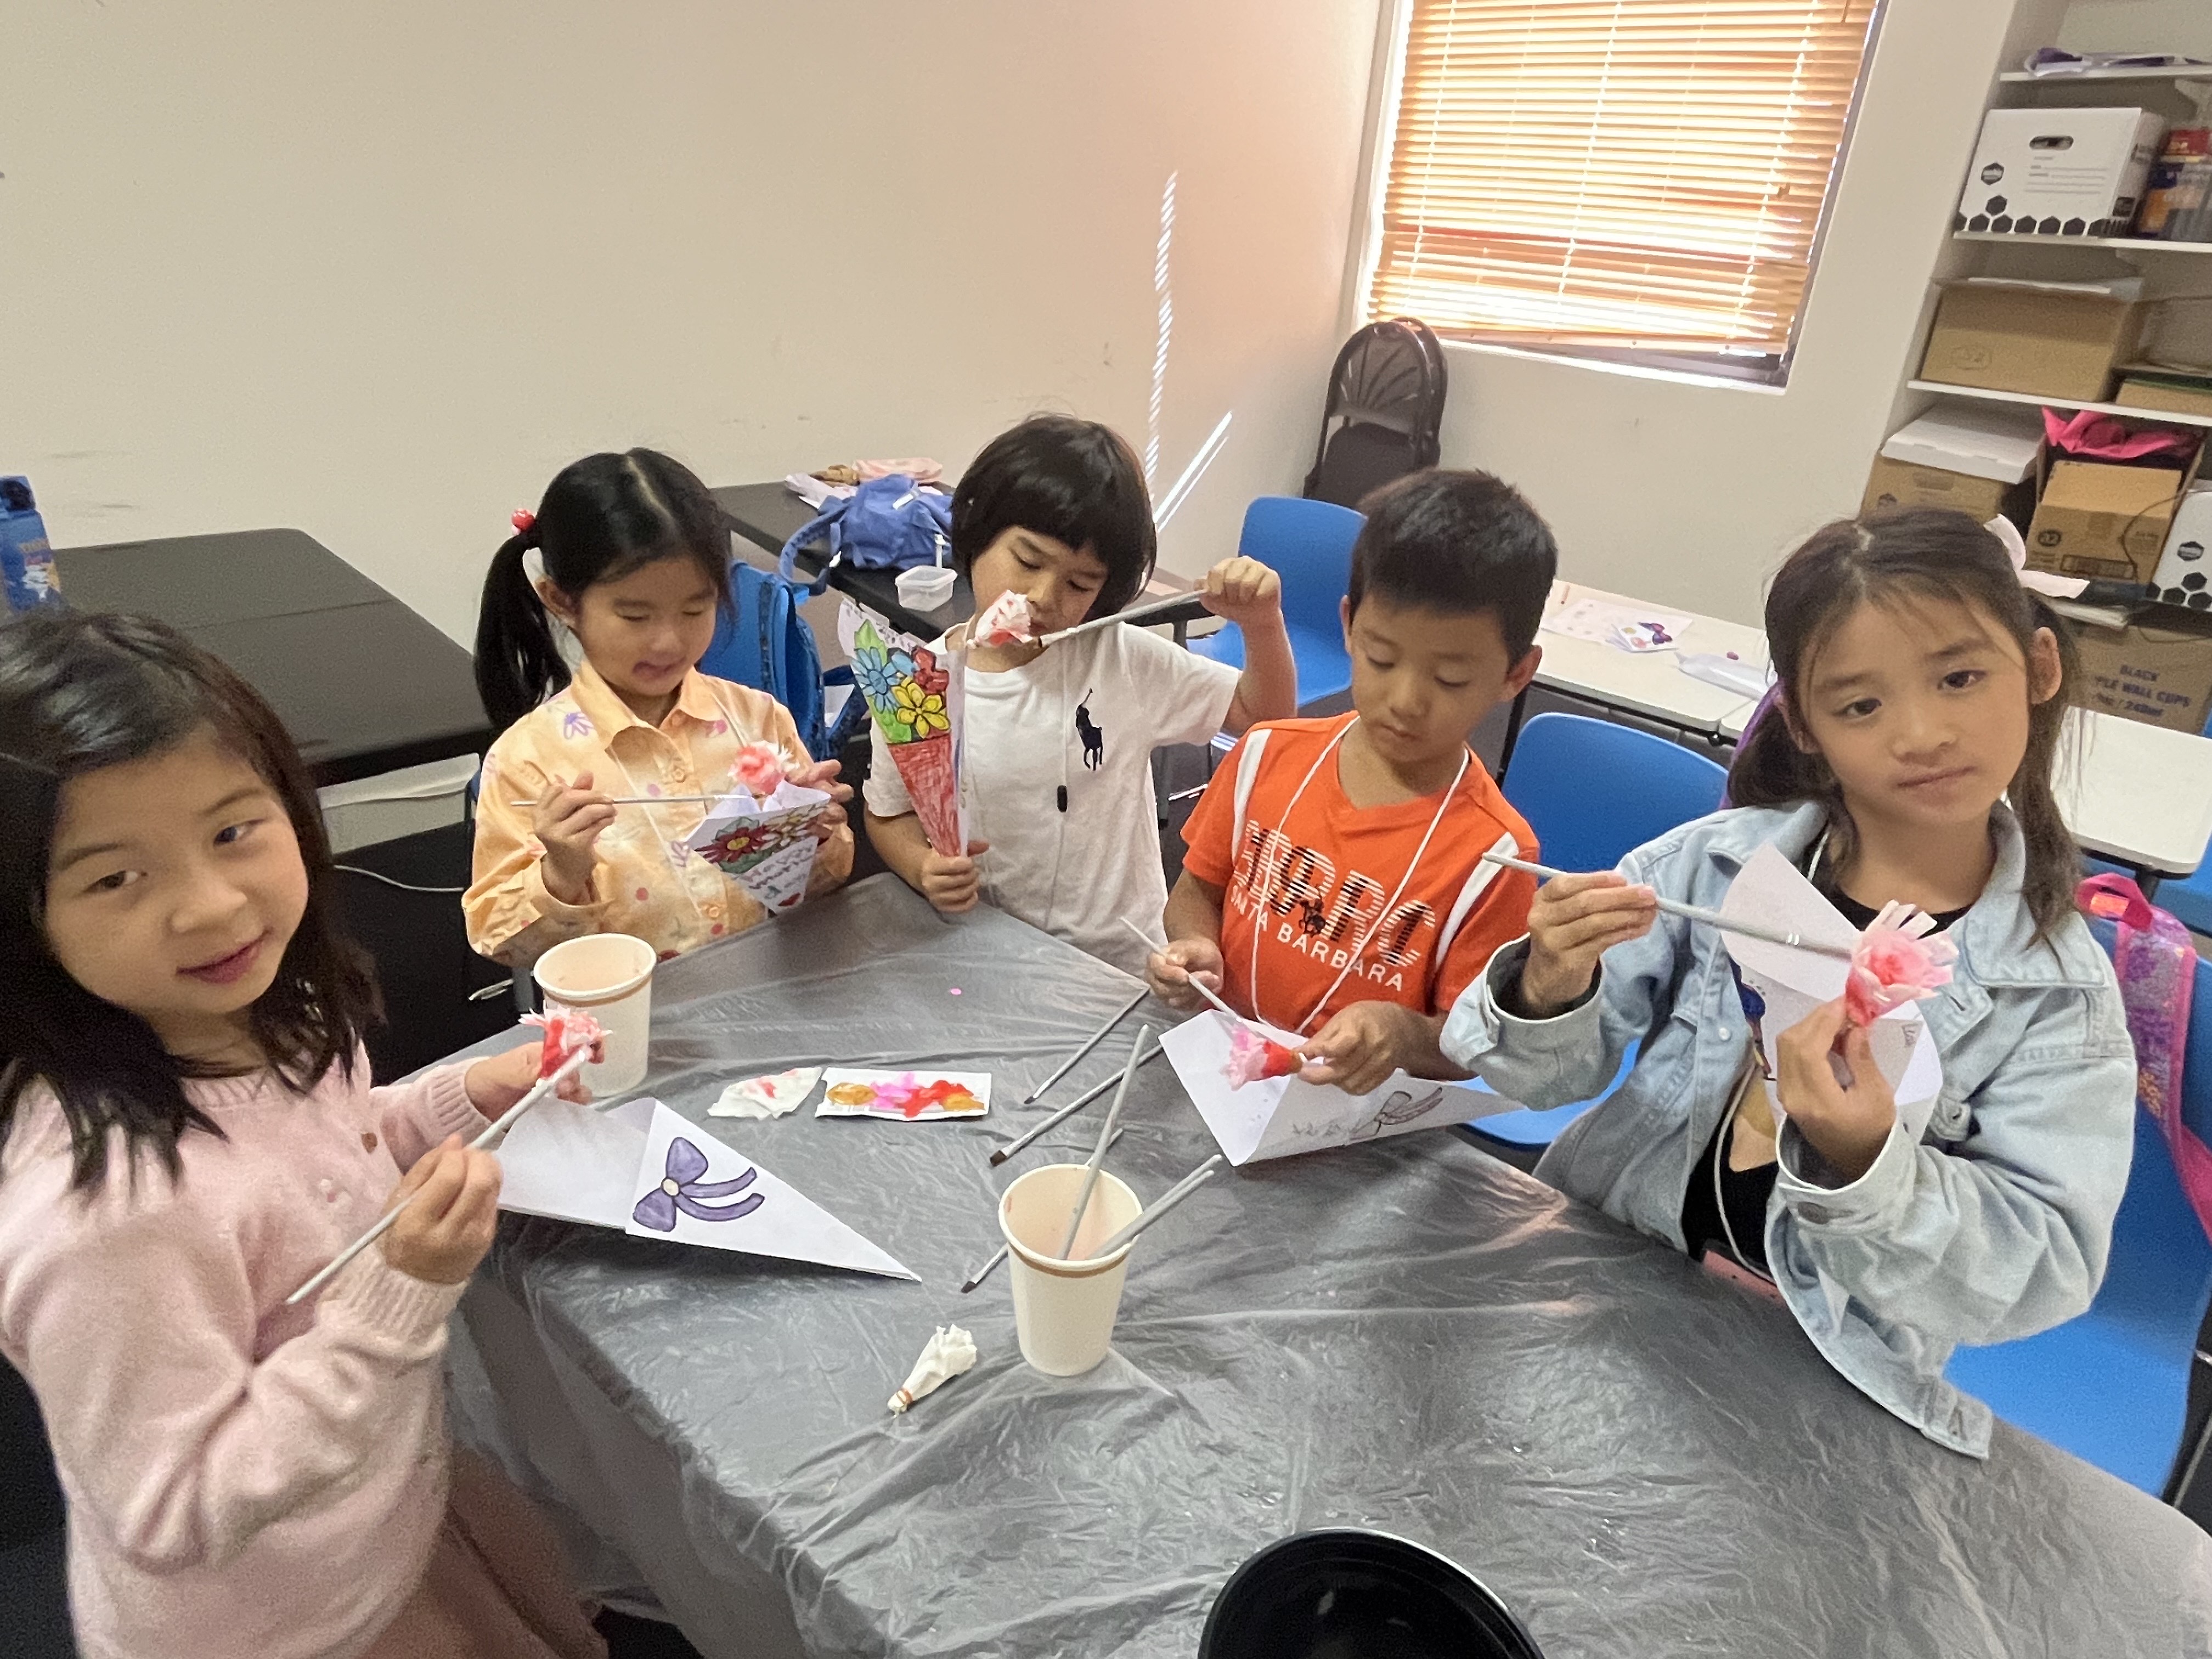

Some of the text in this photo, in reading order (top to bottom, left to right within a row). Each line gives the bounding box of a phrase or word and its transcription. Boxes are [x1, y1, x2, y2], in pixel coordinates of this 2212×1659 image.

[2120, 664, 2160, 682] BLACK
[2122, 682, 2152, 699] WALL
[2156, 691, 2192, 708] CUPS
[1231, 884, 1403, 992] SANTA BARBARA
